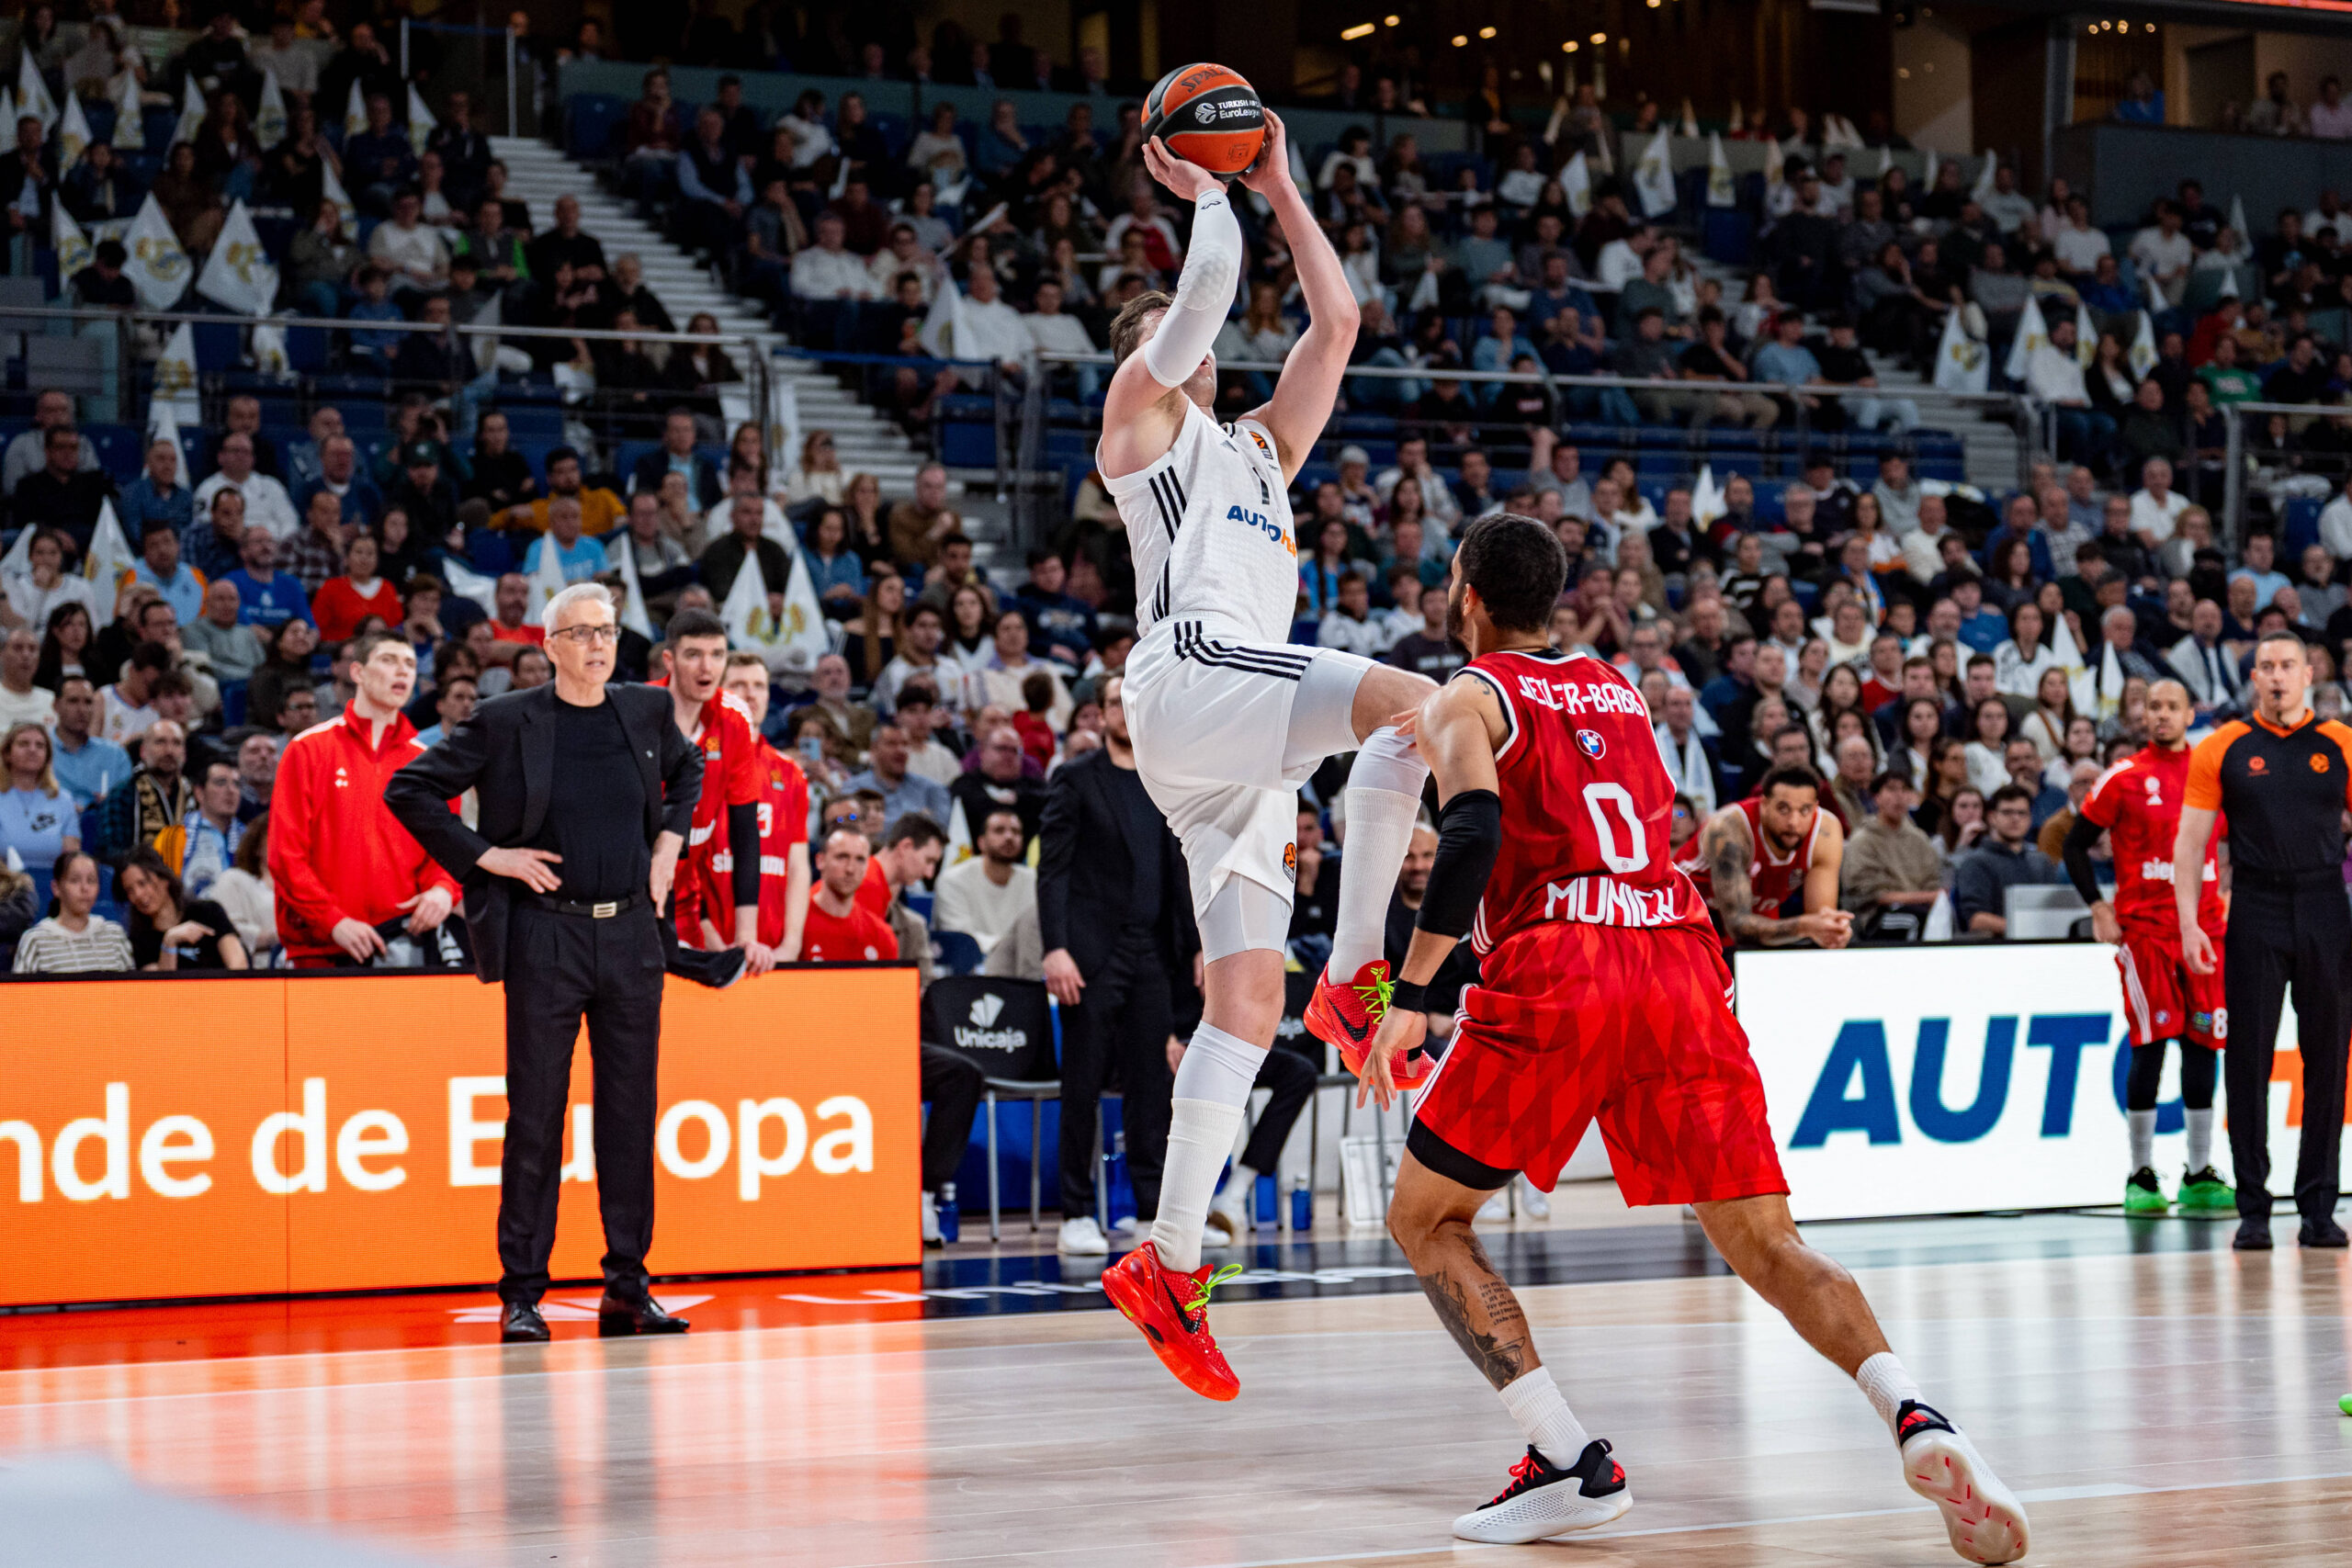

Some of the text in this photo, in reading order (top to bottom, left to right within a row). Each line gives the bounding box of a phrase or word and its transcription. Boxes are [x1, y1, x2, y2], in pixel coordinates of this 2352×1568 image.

[1217, 99, 1249, 109] TURKISH
[1582, 782, 1650, 874] 0
[1544, 876, 1686, 928] MUNICH
[954, 1026, 1028, 1054] Unicaja
[250, 1077, 410, 1194] de
[447, 1075, 874, 1201] Euopa
[776, 1267, 1418, 1304] Uniaja
